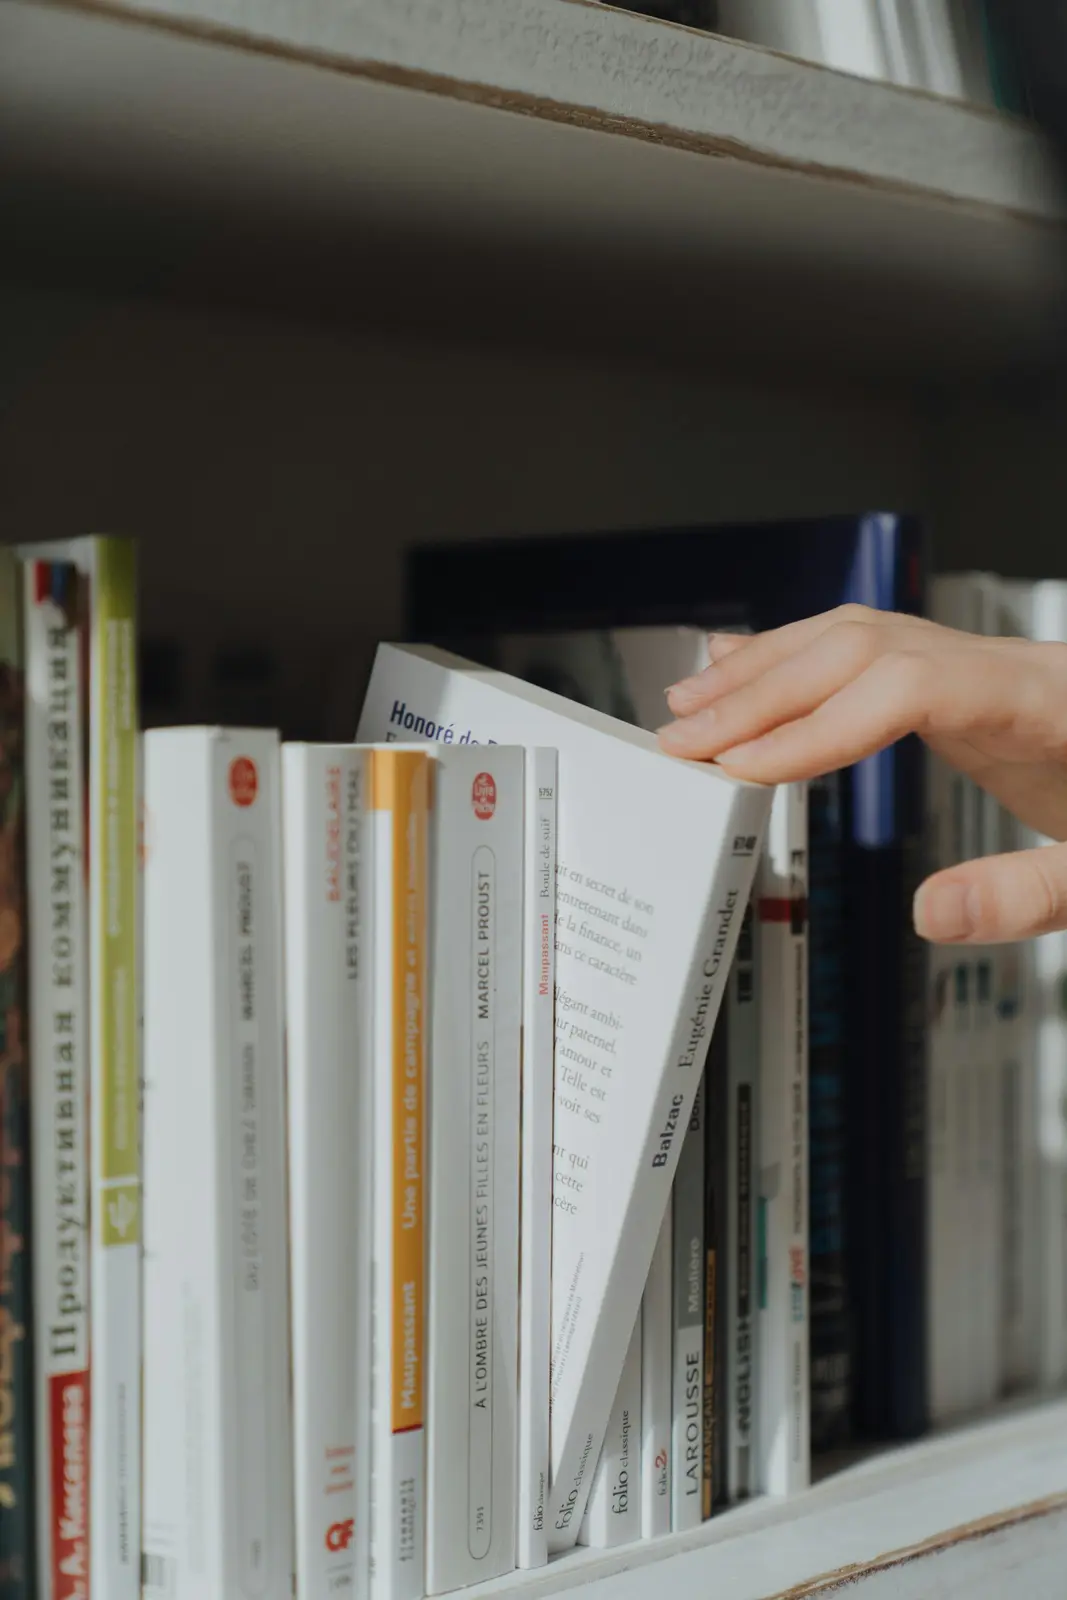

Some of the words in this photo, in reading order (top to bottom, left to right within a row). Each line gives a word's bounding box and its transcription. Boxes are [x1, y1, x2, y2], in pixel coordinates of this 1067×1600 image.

[389, 700, 455, 745] Honoré
[47, 626, 81, 989] коммуникация
[538, 816, 551, 840] suif
[539, 843, 551, 859] de
[539, 862, 551, 898] Boule
[477, 870, 491, 941] PROUST
[477, 946, 491, 1020] MARCEL
[538, 913, 552, 996] Maupassant
[677, 983, 714, 1068] Eugénie
[702, 888, 739, 978] Grandet
[403, 972, 421, 1079] campagne
[403, 1084, 418, 1111] de
[476, 1040, 491, 1107] FLEURS
[561, 1065, 588, 1092] Telle
[402, 1118, 420, 1180] partie
[476, 1112, 490, 1137] EN
[651, 1093, 684, 1168] Balzac
[48, 1010, 86, 1358] Продуктивная
[476, 1141, 490, 1199] FILLES
[556, 1171, 583, 1193] cette
[569, 1153, 591, 1170] qui
[401, 1185, 417, 1229] Une
[475, 1204, 490, 1270] JEUNES
[475, 1275, 490, 1311] DES
[686, 1237, 701, 1313] Molière
[400, 1280, 419, 1409] Maupassant
[474, 1316, 490, 1393] L'OMBRE
[619, 1409, 632, 1468] classique
[685, 1351, 700, 1496] LAROUSSE
[554, 1488, 579, 1530] folio
[573, 1432, 594, 1487] classique
[611, 1470, 629, 1514] folio
[533, 1505, 544, 1531] folio
